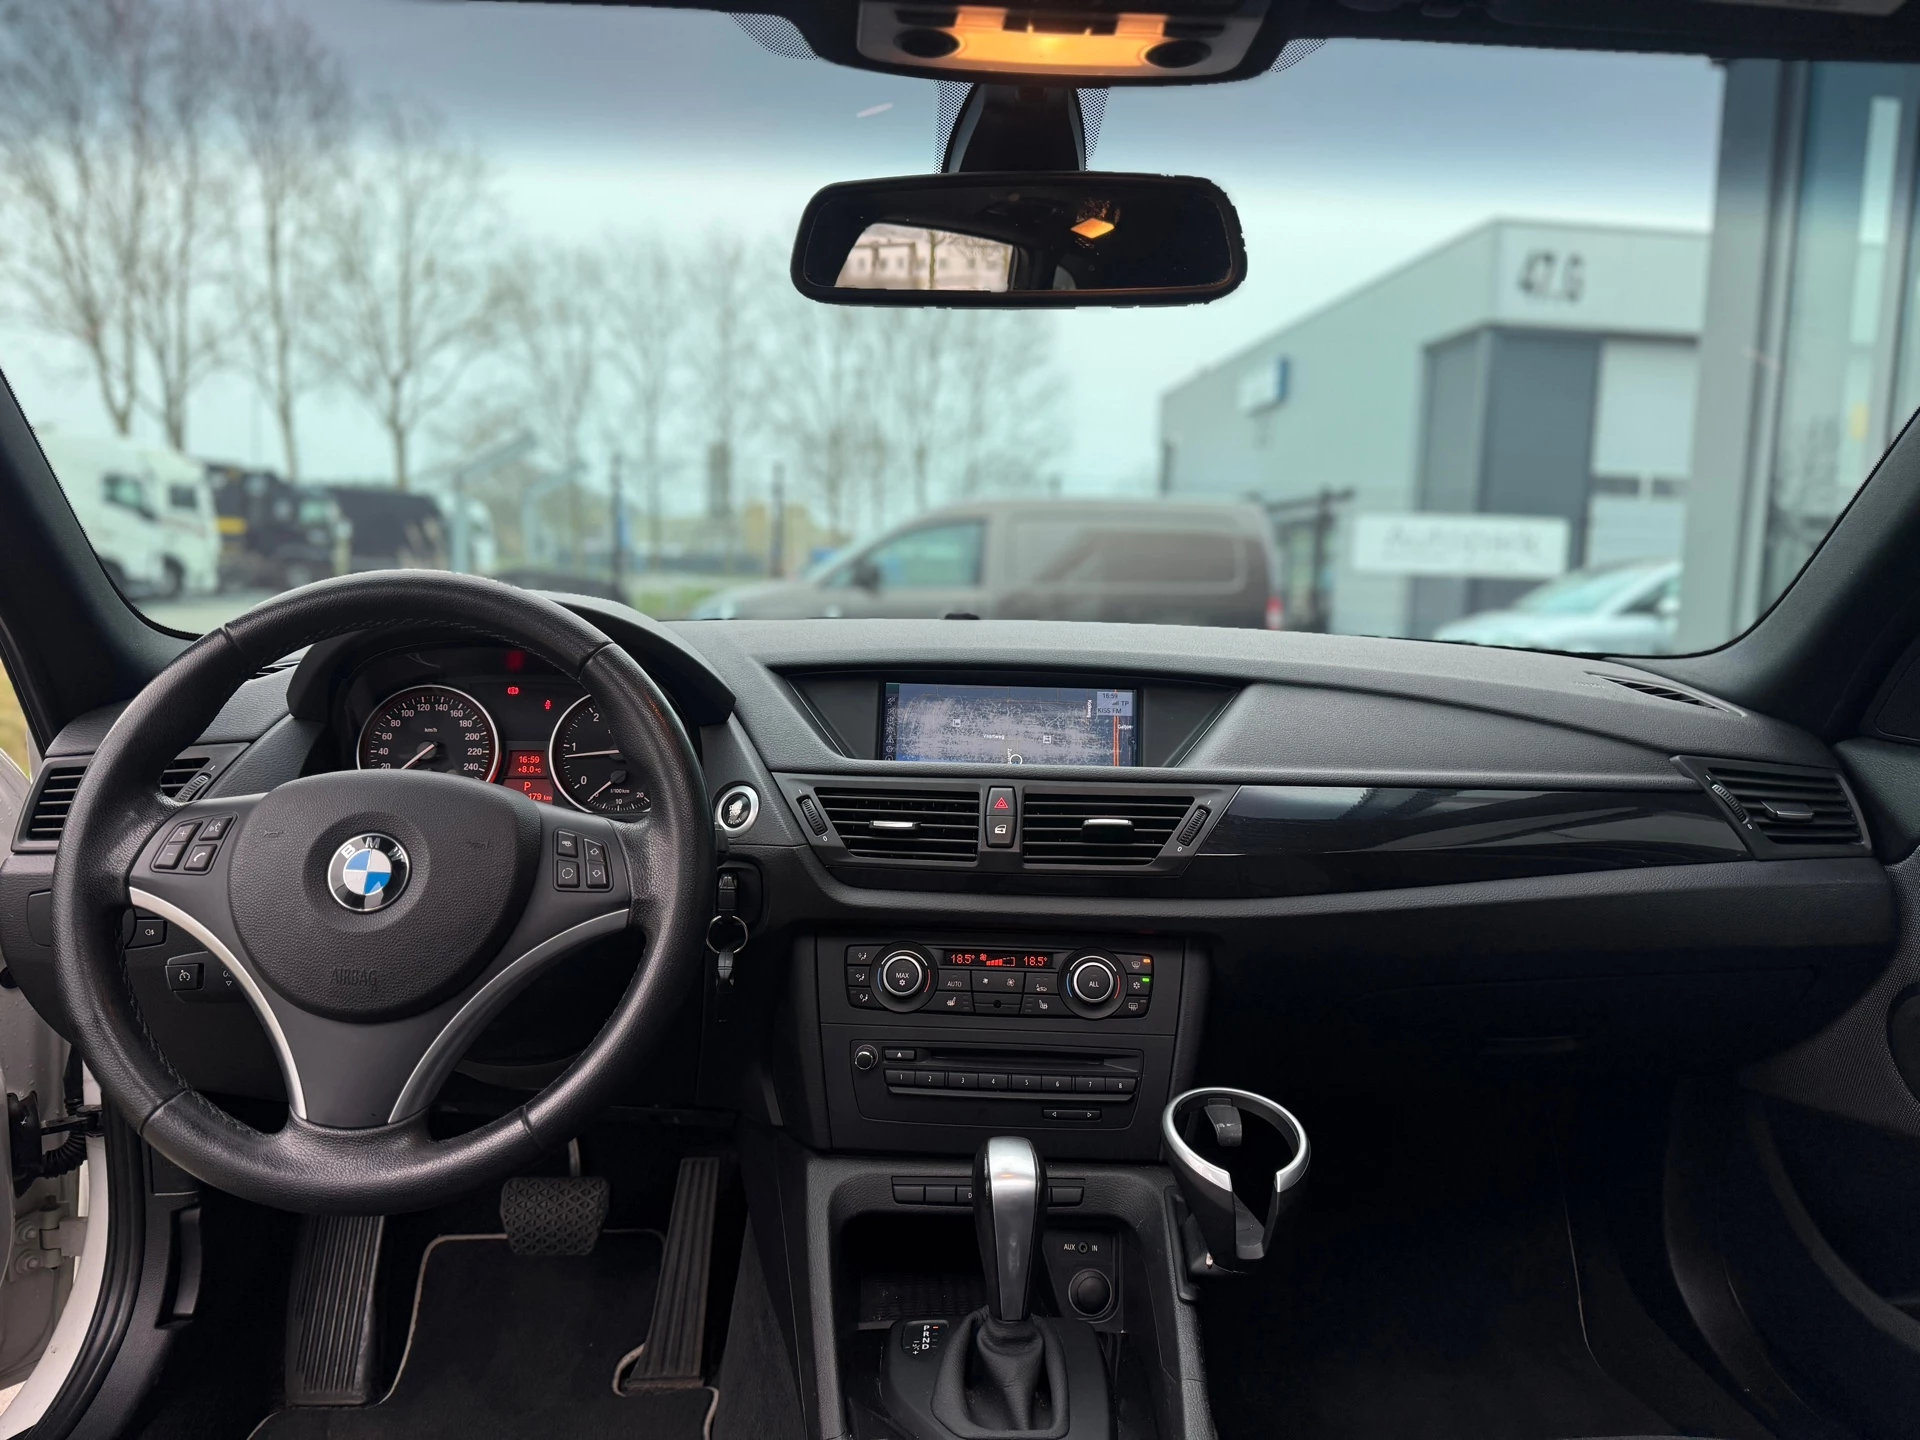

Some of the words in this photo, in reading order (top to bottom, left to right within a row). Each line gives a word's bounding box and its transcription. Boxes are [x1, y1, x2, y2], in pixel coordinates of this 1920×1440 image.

[450, 710, 464, 718] 160
[593, 712, 600, 722] 2
[467, 747, 482, 755] 220
[572, 742, 576, 751] 1
[518, 756, 540, 764] 16:59
[463, 762, 478, 770] 240
[580, 775, 587, 785] 0
[524, 781, 531, 791] P
[528, 792, 542, 800] 179
[341, 836, 405, 862] BMW
[330, 968, 378, 987] AIRBAG
